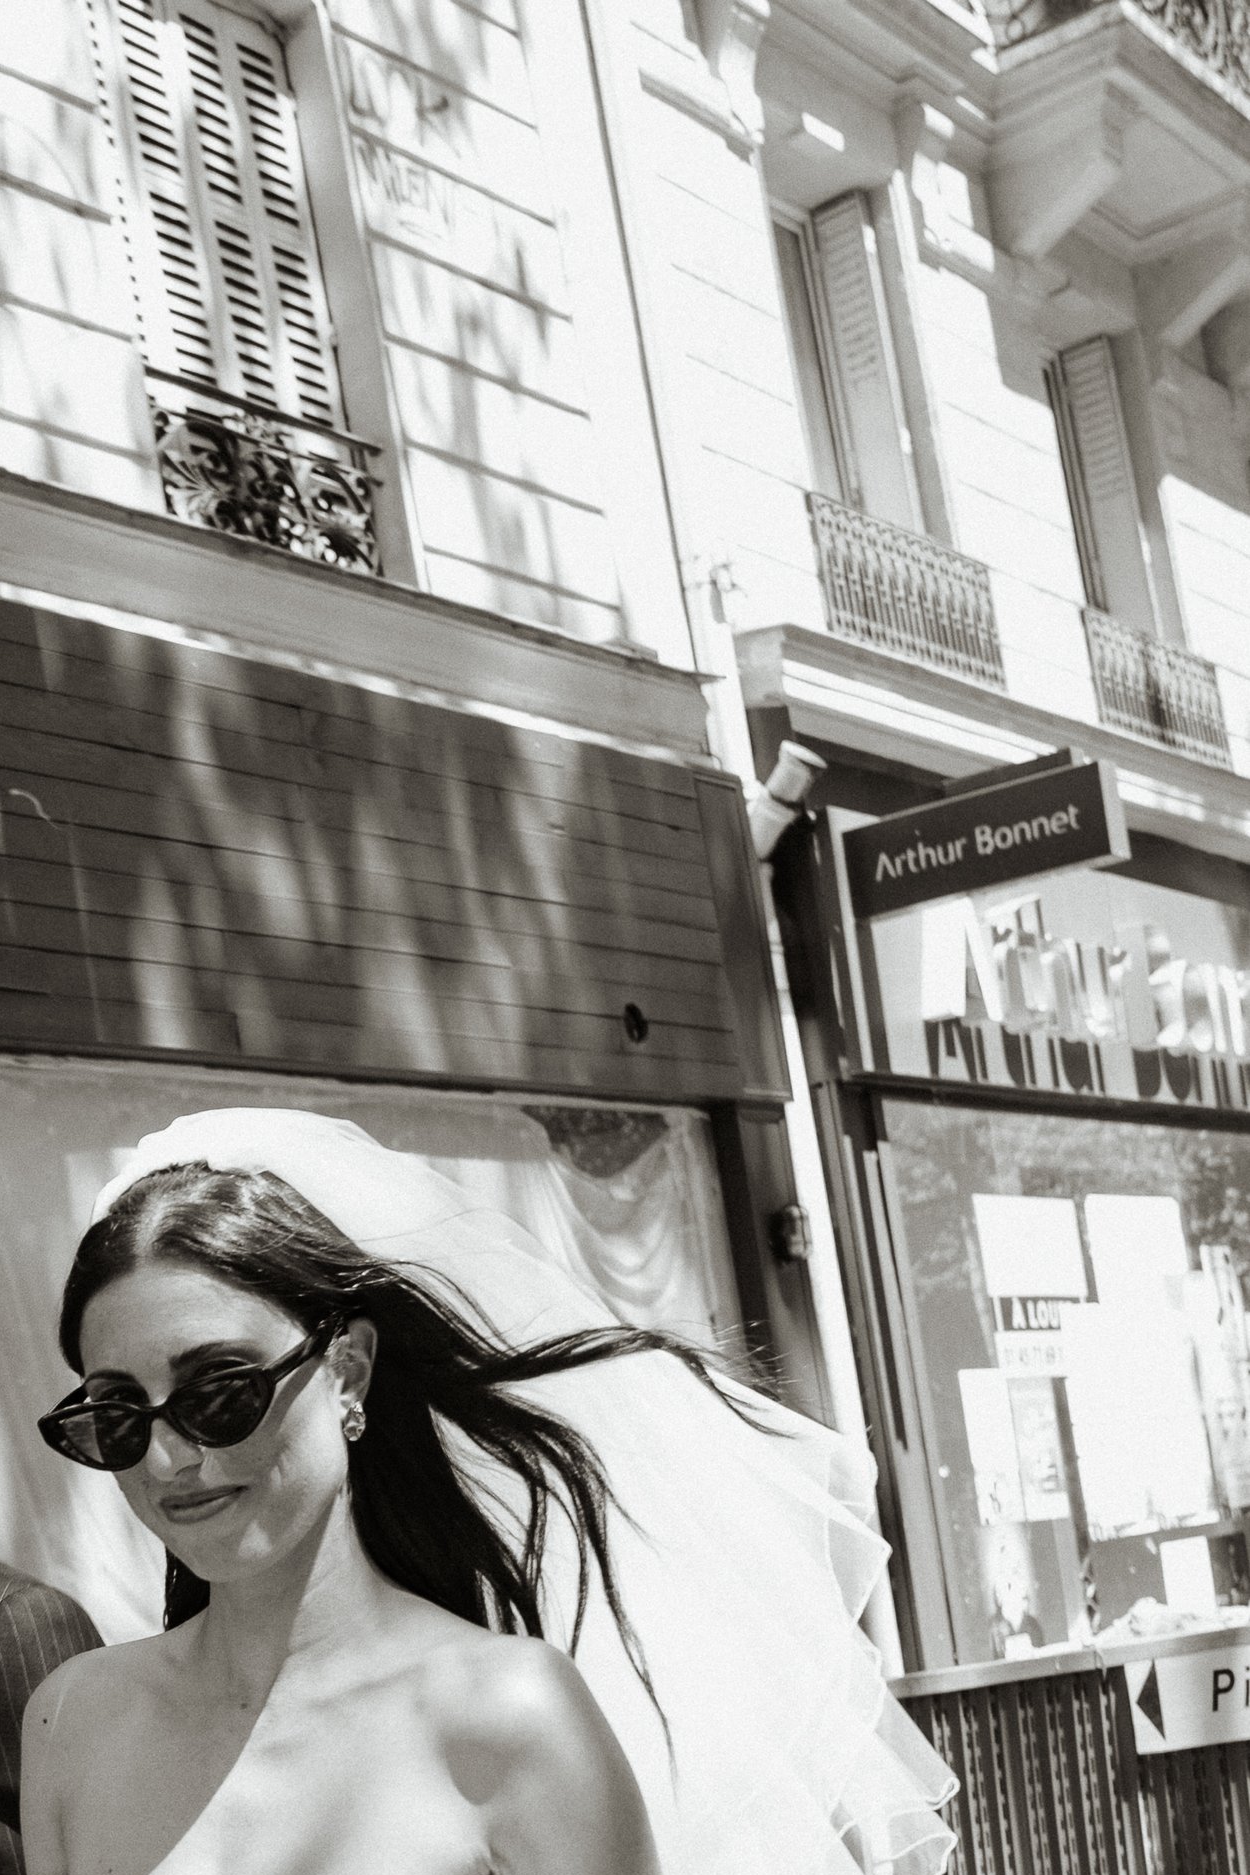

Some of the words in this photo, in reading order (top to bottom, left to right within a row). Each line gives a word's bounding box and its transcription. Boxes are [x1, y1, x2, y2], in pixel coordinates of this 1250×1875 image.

[875, 833, 967, 882] Arthur
[974, 804, 1081, 855] Bonnet
[1027, 1299, 1060, 1329] LOU
